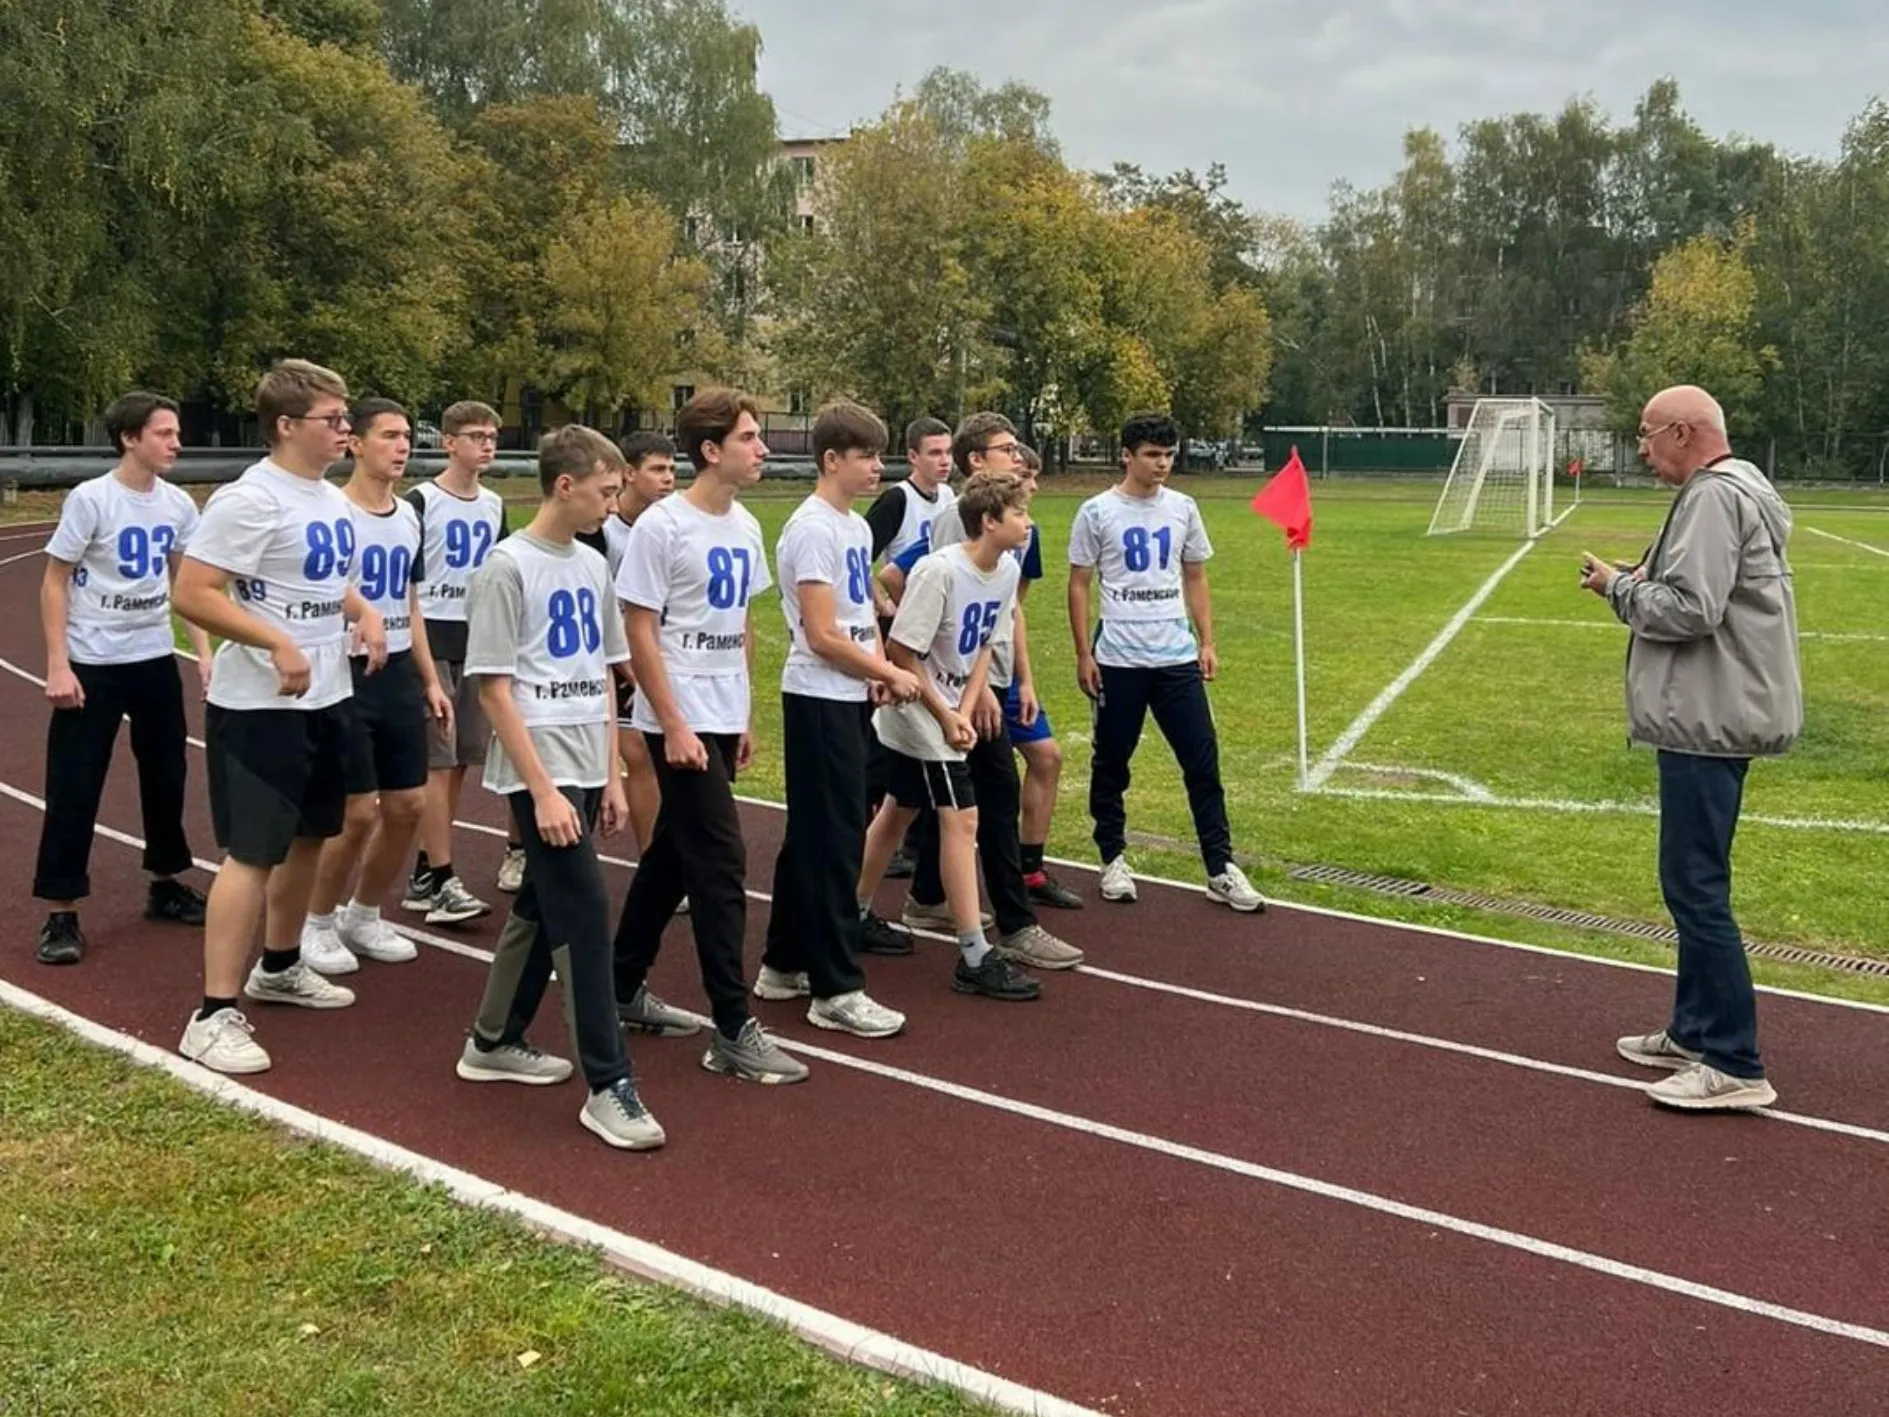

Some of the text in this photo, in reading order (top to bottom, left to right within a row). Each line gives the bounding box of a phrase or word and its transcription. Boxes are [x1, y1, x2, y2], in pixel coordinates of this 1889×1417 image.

[118, 525, 175, 580] 93
[303, 517, 355, 581] 89
[445, 519, 492, 569] 92
[1122, 527, 1172, 573] 81
[235, 578, 267, 601] 89
[360, 544, 410, 601] 90
[706, 546, 750, 610] 87
[547, 587, 601, 659] 88
[682, 633, 694, 650] г.
[958, 601, 1001, 656] 85
[535, 684, 548, 700] г.
